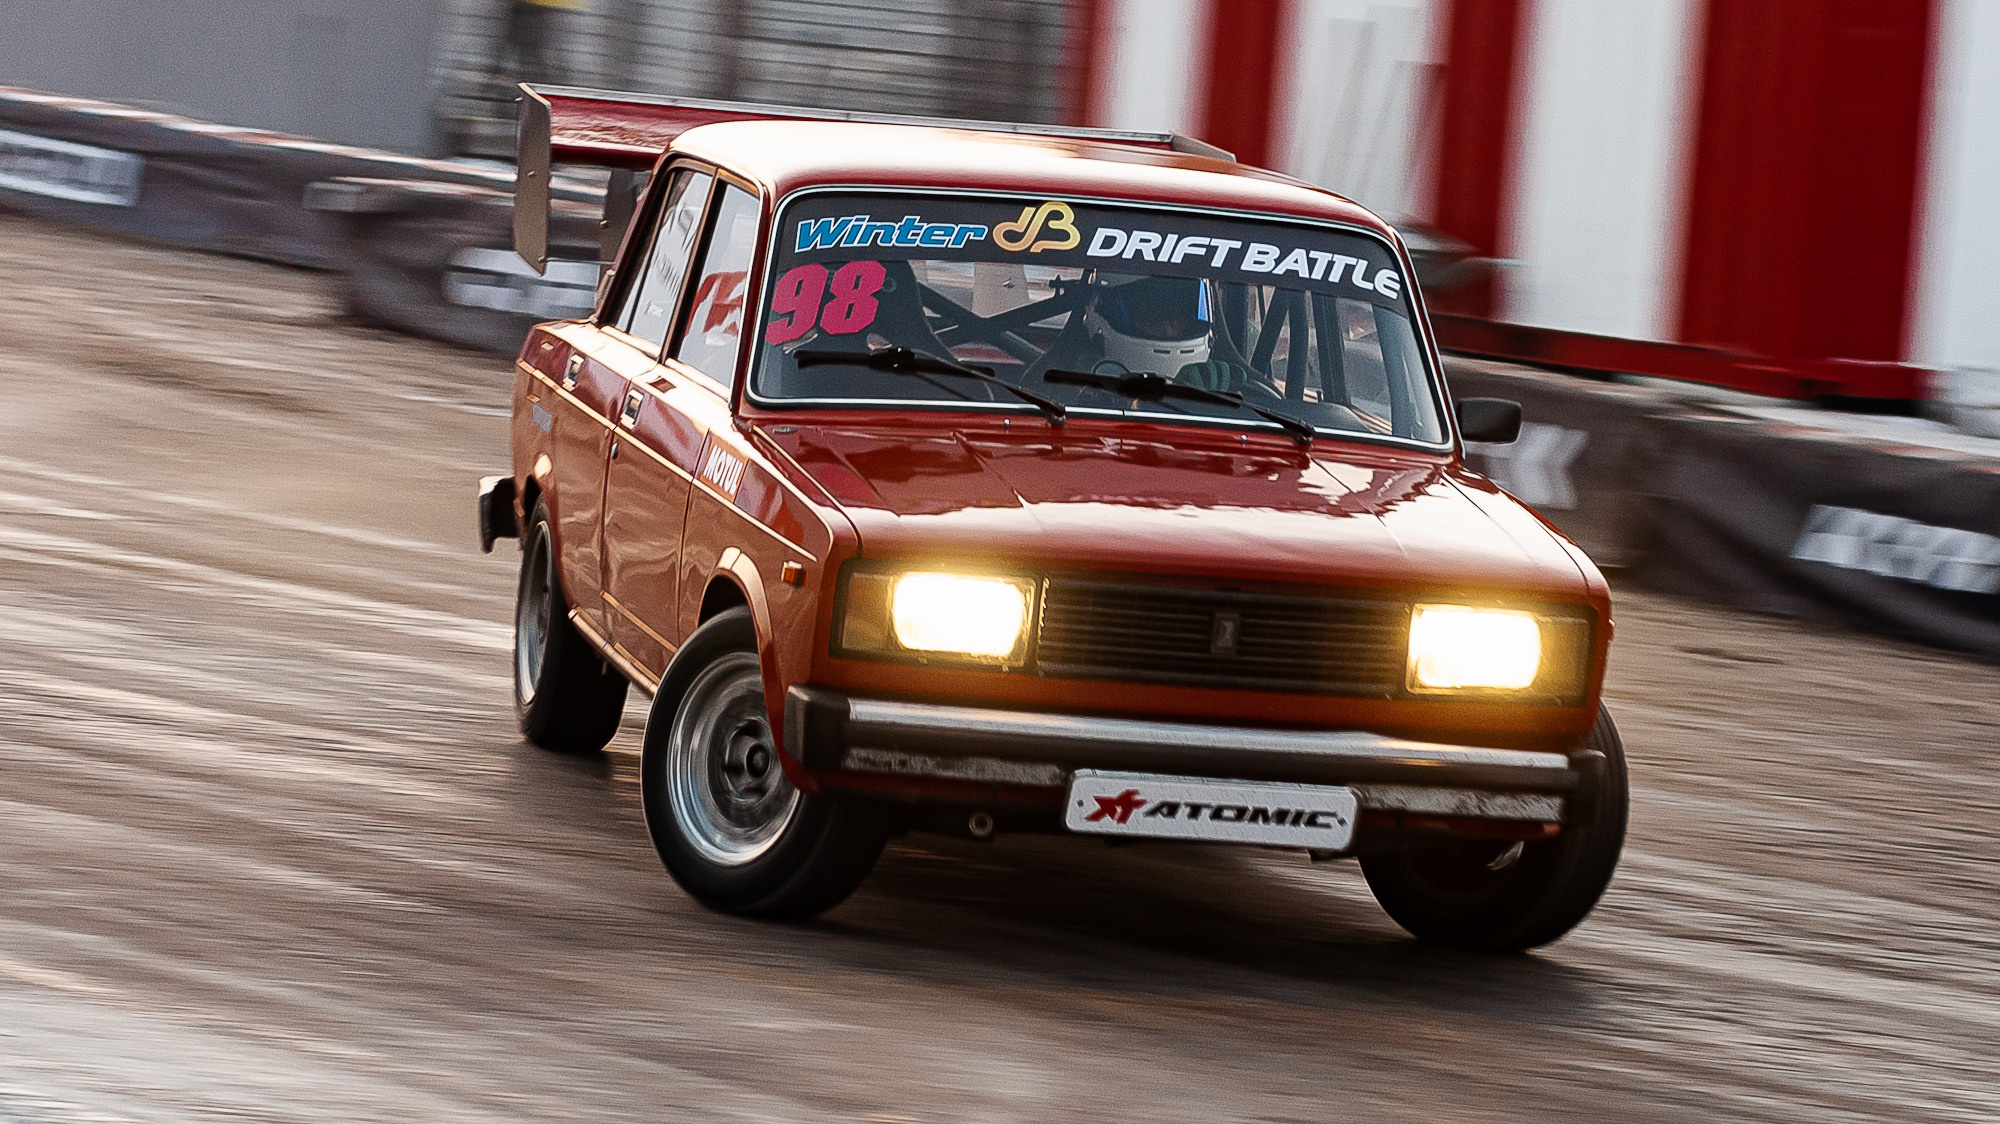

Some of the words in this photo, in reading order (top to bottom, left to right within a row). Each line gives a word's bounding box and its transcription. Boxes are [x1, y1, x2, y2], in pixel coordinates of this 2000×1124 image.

[795, 215, 988, 253] Winter
[1087, 227, 1242, 268] DRIFT
[1241, 242, 1401, 300] BATTLE
[765, 260, 887, 346] 98
[703, 444, 743, 496] MOTUL
[1142, 800, 1338, 829] ATOMIC
